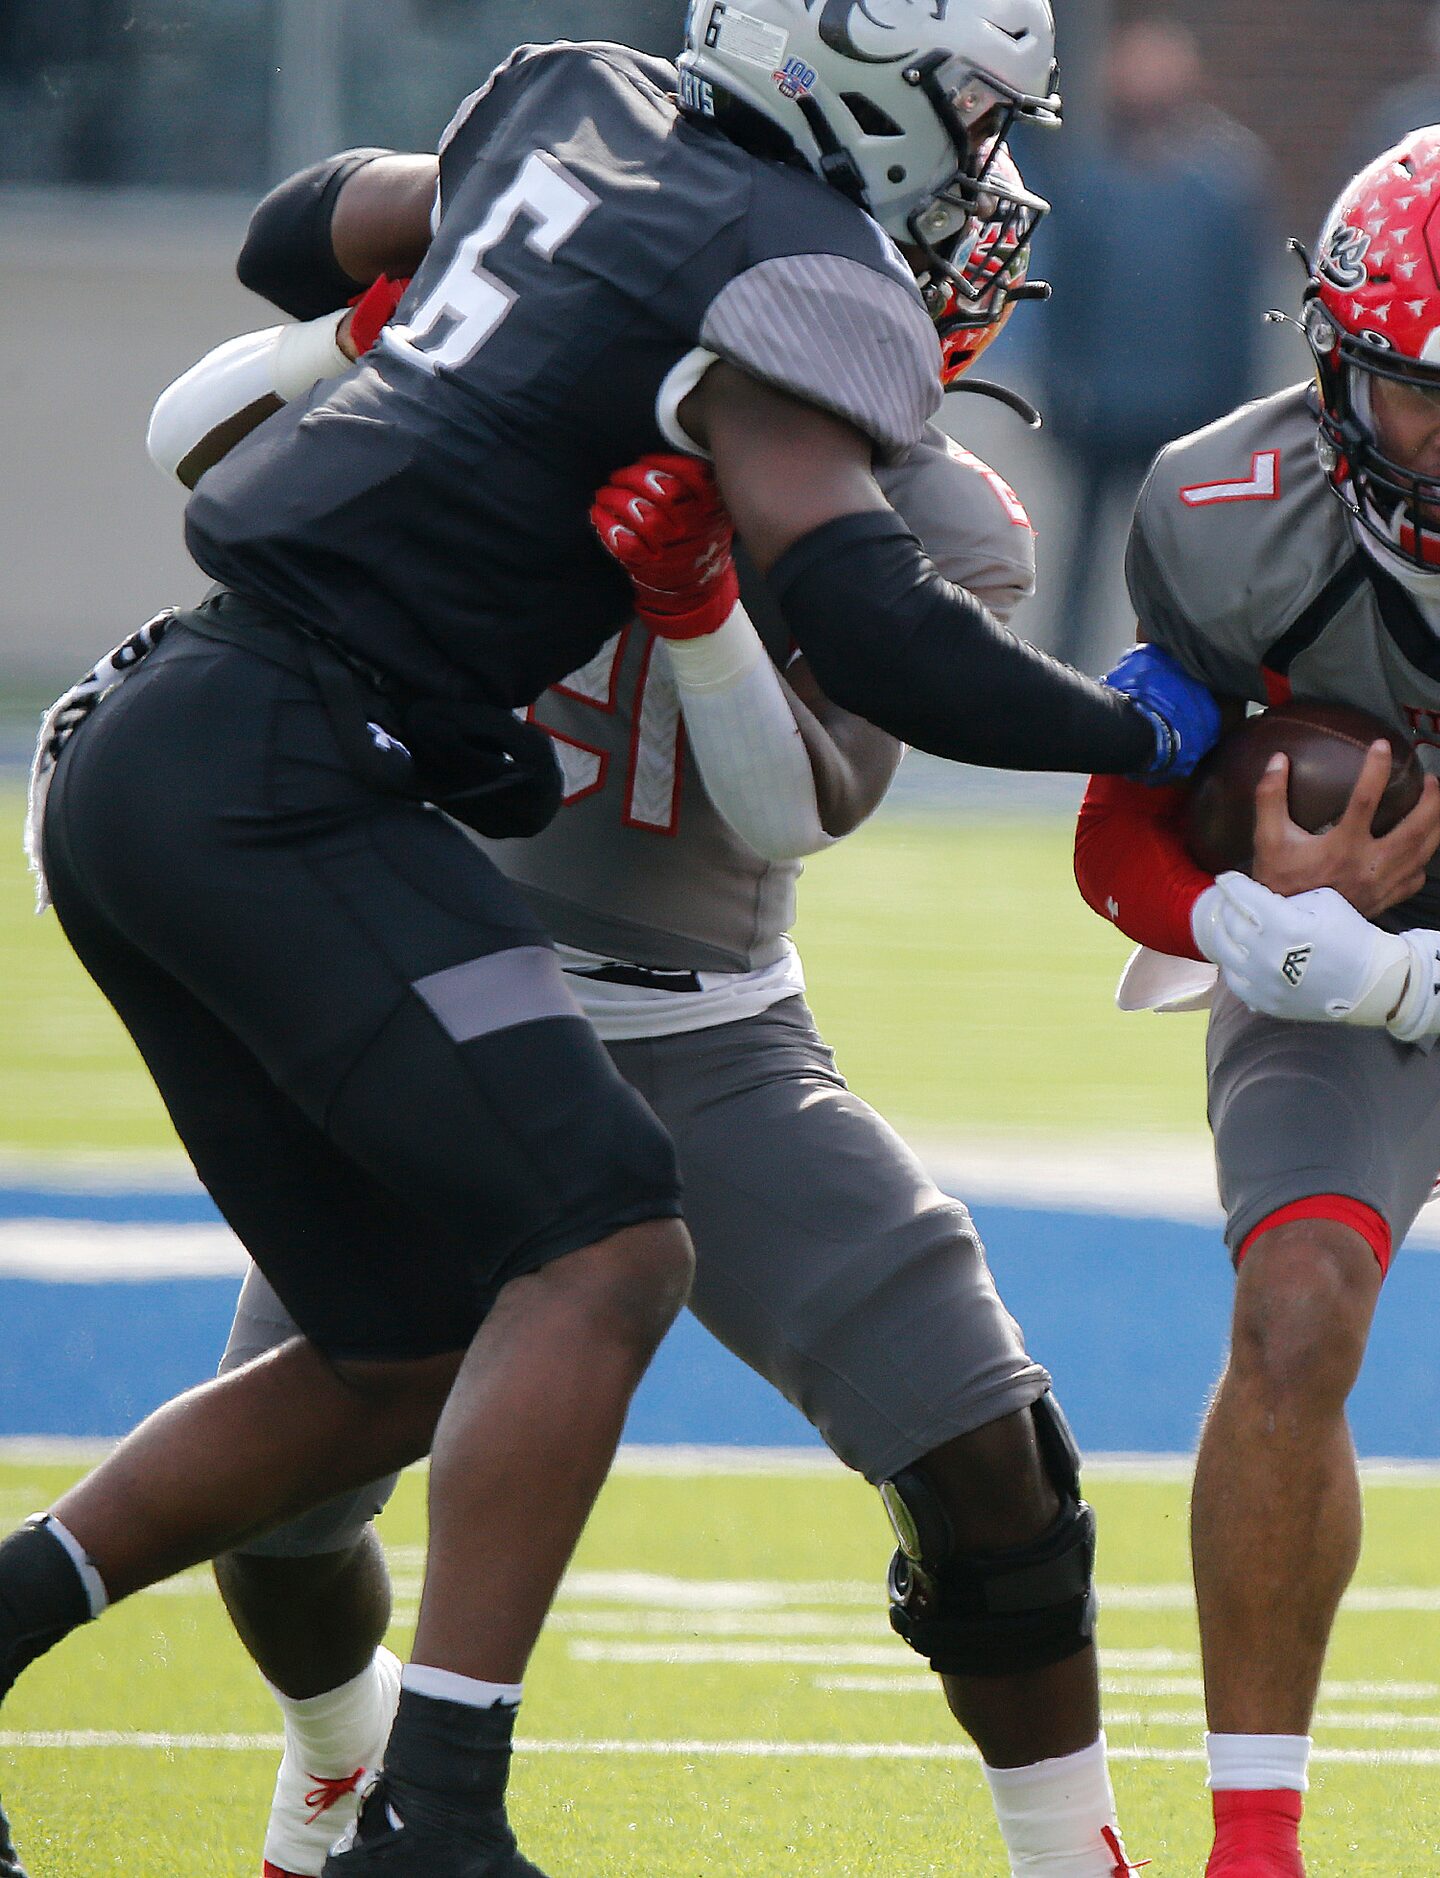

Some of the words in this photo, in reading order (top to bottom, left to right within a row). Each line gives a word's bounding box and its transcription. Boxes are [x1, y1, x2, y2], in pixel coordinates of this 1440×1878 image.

[704, 2, 726, 48] 6
[782, 55, 817, 88] 100
[379, 148, 603, 378] 6
[1180, 448, 1281, 507] 7
